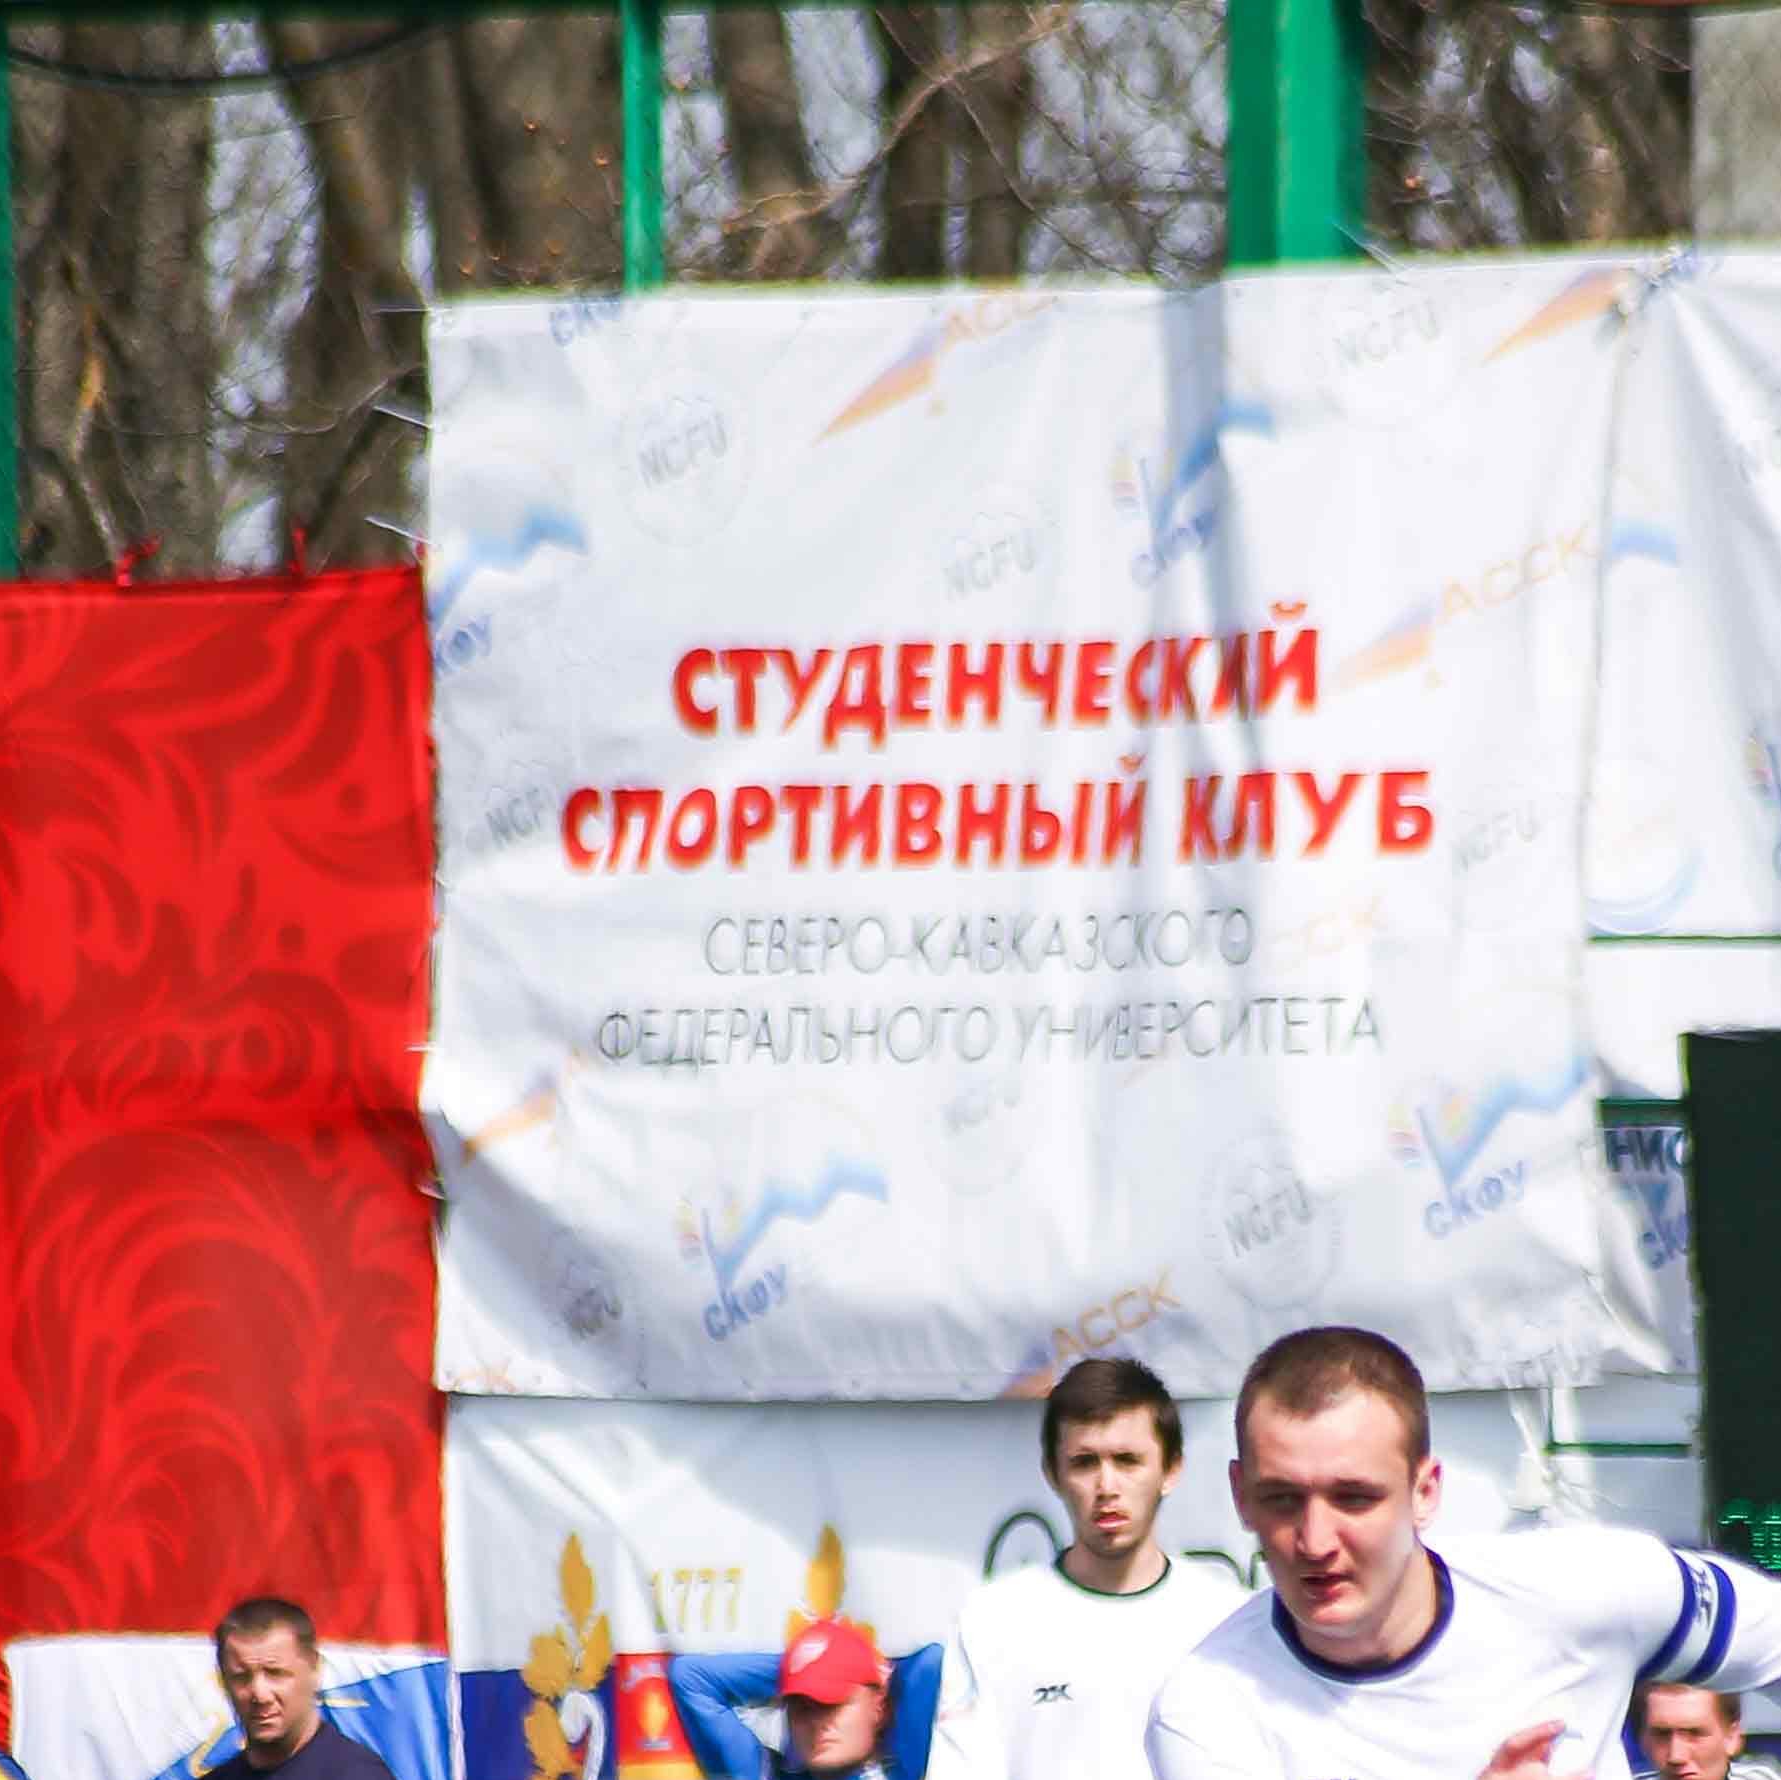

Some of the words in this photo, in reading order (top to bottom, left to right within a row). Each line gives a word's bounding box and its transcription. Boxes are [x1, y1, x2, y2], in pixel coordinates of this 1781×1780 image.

[638, 411, 729, 488] NCFU
[672, 598, 1318, 748] СТУДЕНЧЕСКИЙ
[561, 755, 1146, 874] СПОРТИВНЫЙ
[1176, 769, 1435, 864] КЛУБ
[704, 907, 1254, 976] СЕВЕРО-КАВКАЗСКОГО
[596, 1003, 998, 1076] ФЕДЕРАЛЬНОГО
[1013, 996, 1384, 1062] УНИВЕРСИТЕТА
[1223, 1179, 1313, 1258] NCFU
[1053, 1264, 1182, 1362] АССК
[651, 1566, 744, 1634] 1777
